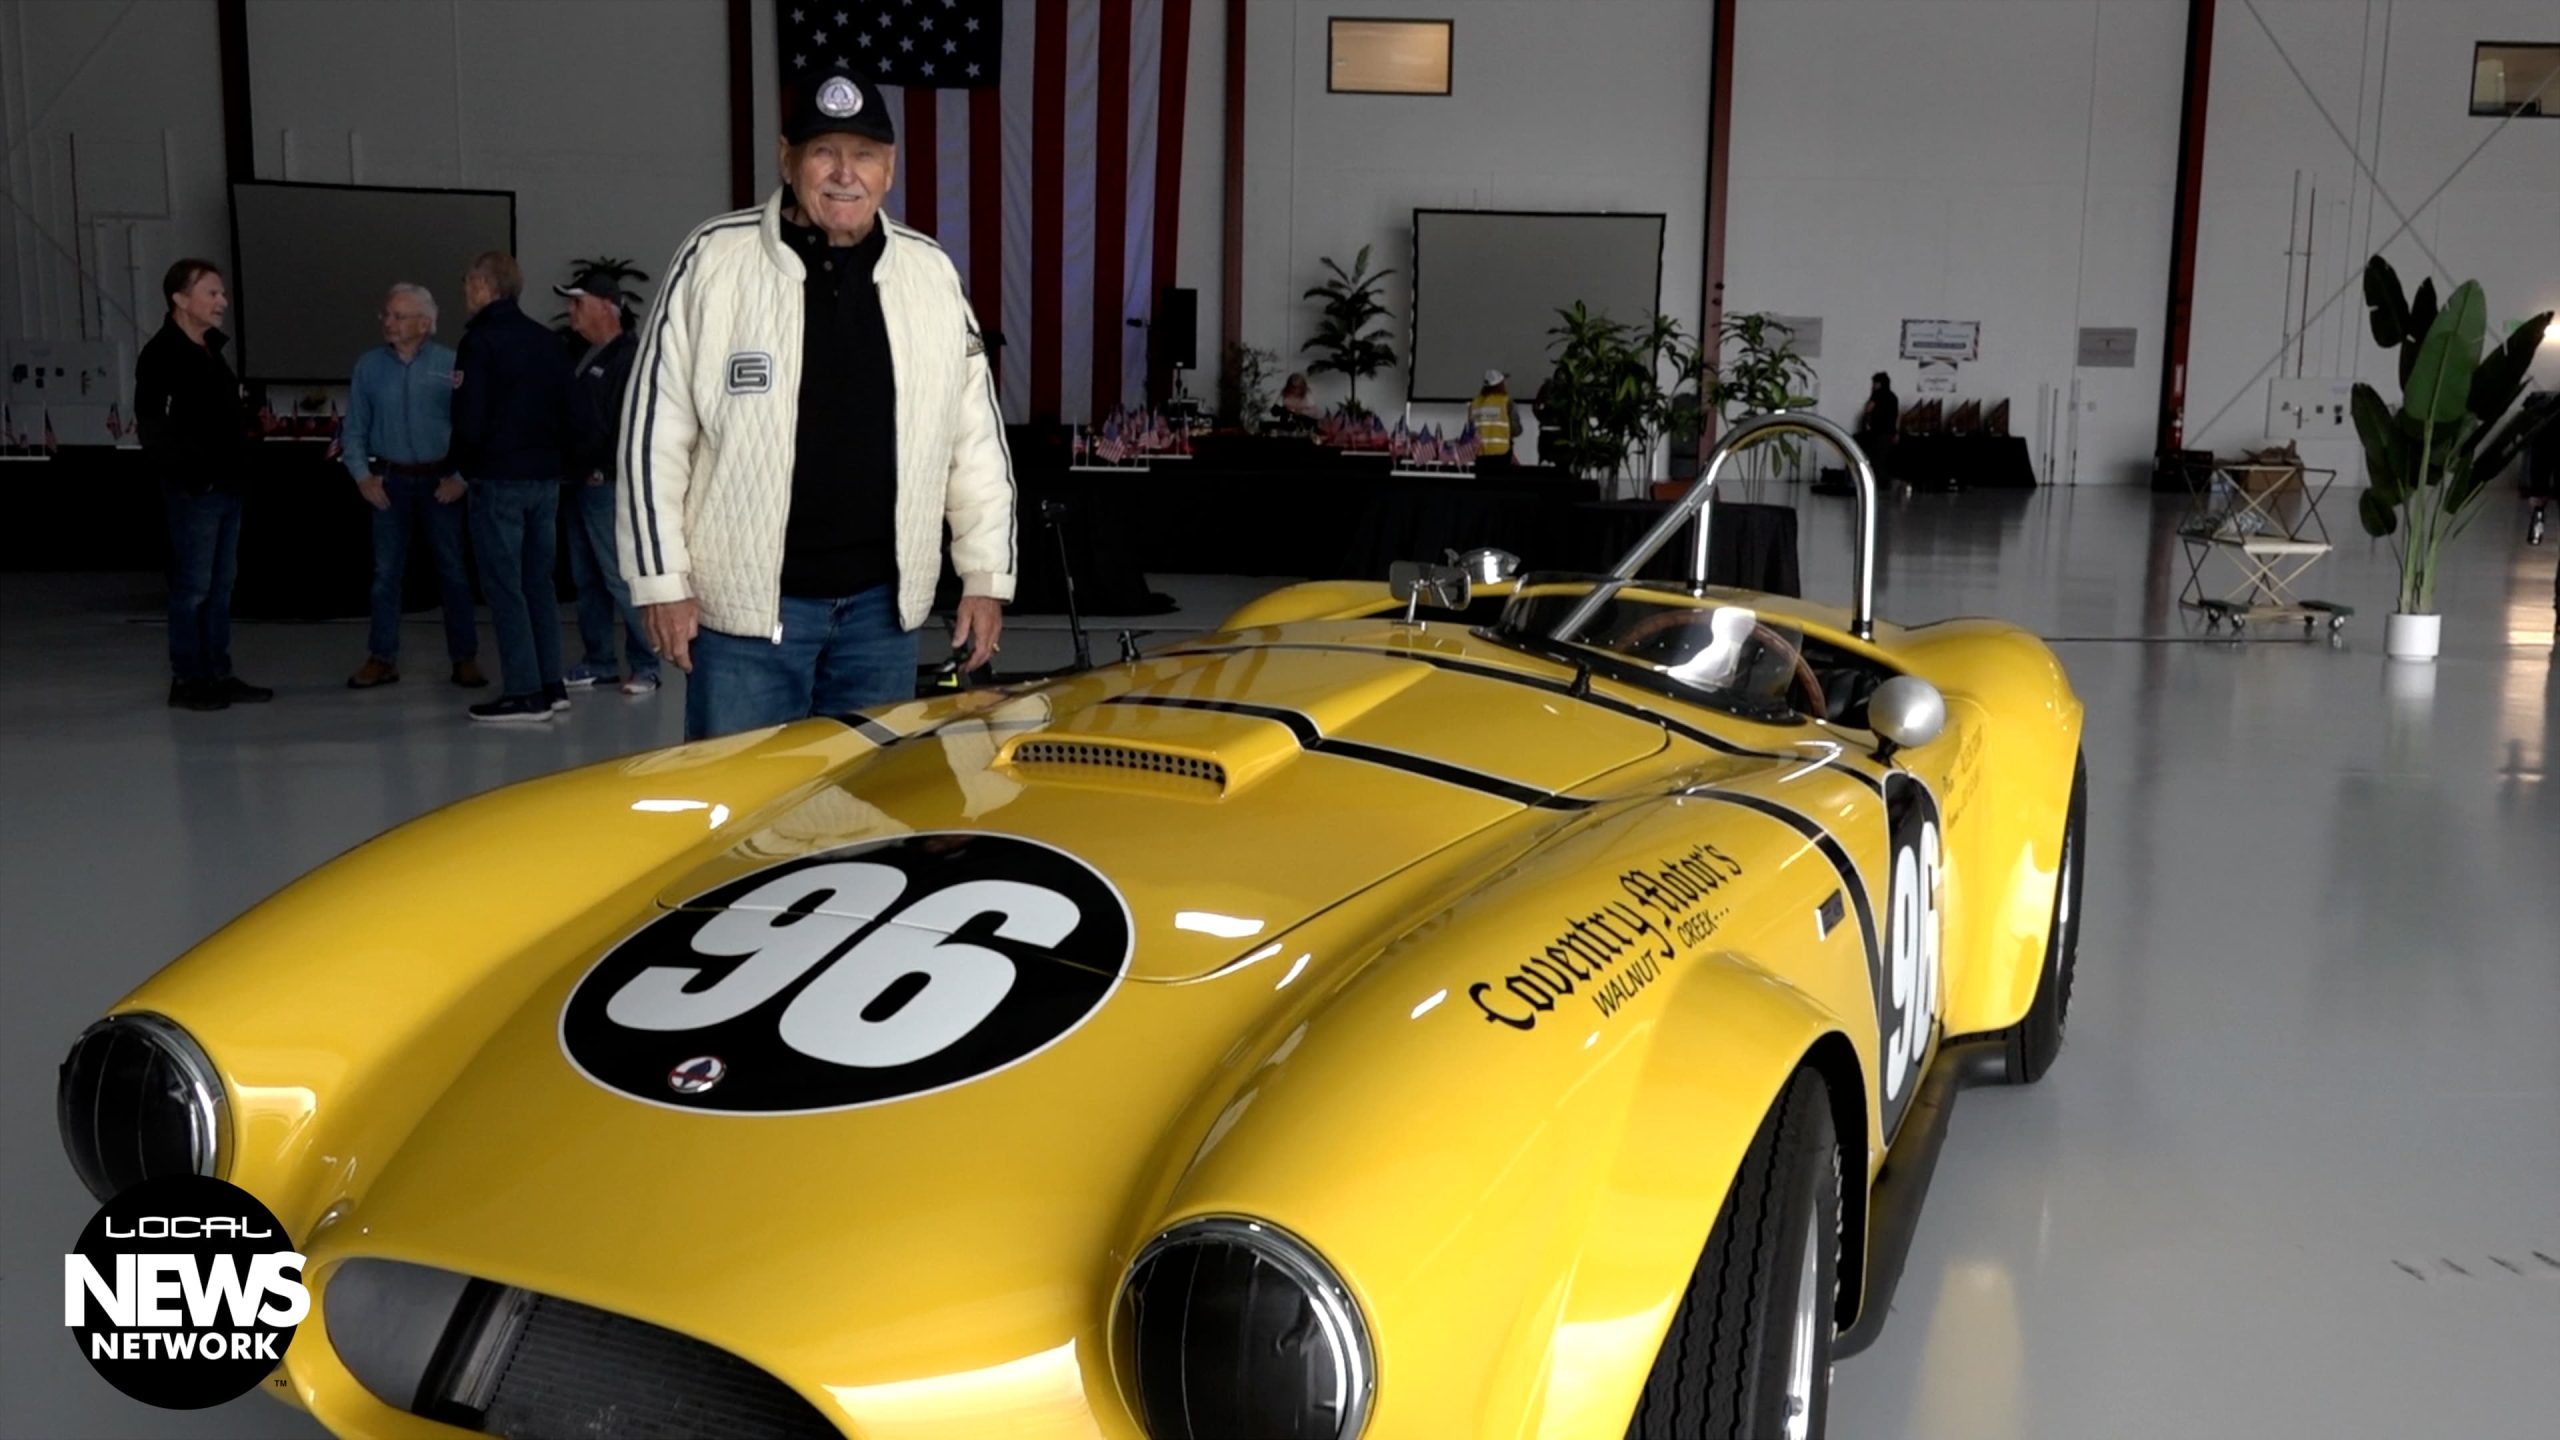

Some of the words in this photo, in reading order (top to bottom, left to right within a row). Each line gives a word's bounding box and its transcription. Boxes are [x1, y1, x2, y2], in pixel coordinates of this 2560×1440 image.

[606, 861, 1080, 1068] 96
[1468, 900, 1675, 1031] Coventry
[1591, 948, 1663, 1018] WALNUT
[1886, 821, 1940, 1101] 96
